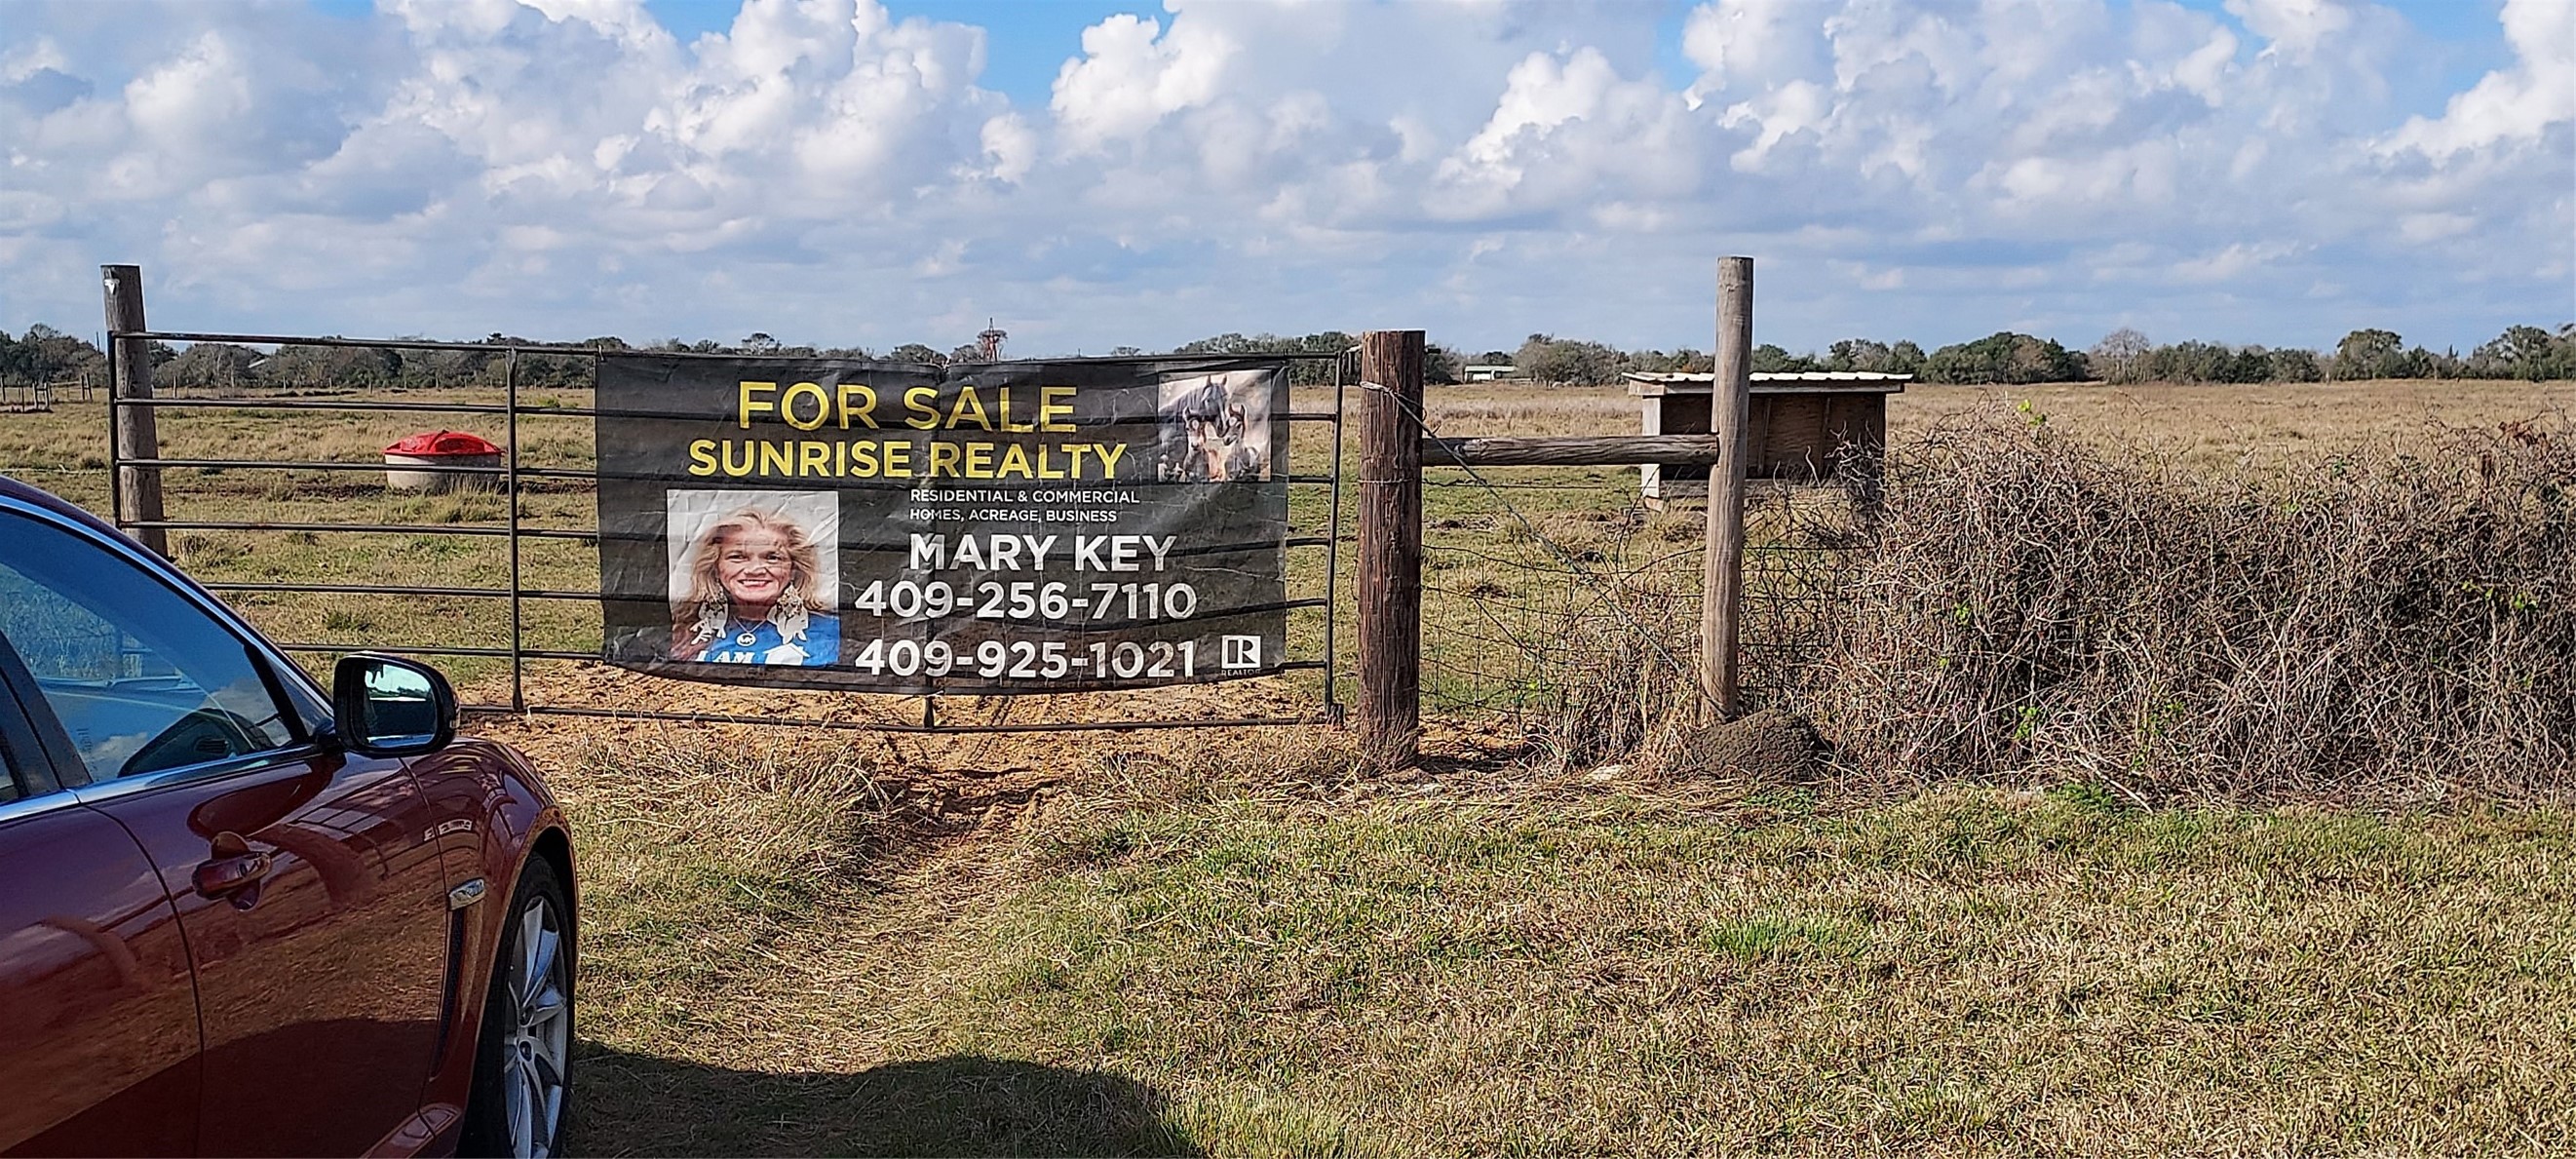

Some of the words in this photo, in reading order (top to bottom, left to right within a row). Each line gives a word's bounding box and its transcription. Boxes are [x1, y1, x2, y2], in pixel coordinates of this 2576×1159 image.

[739, 381, 879, 431] FOR
[904, 386, 1077, 433] SALE
[688, 439, 912, 478] SUNRISE
[930, 442, 1127, 480] REALTY
[909, 508, 965, 522] HOMES,
[969, 509, 1042, 523] ACREAGE,
[1046, 510, 1117, 522] BUSINESS
[910, 489, 1014, 503] RESIDENTIAL
[1017, 490, 1028, 503] &
[1032, 490, 1140, 504] COMMERCIAL
[909, 533, 1057, 571] MARY
[1075, 535, 1178, 572] KEY
[855, 581, 1198, 620] 409-256-7110
[712, 650, 755, 664] AM
[855, 638, 1195, 678] 409-925-1021
